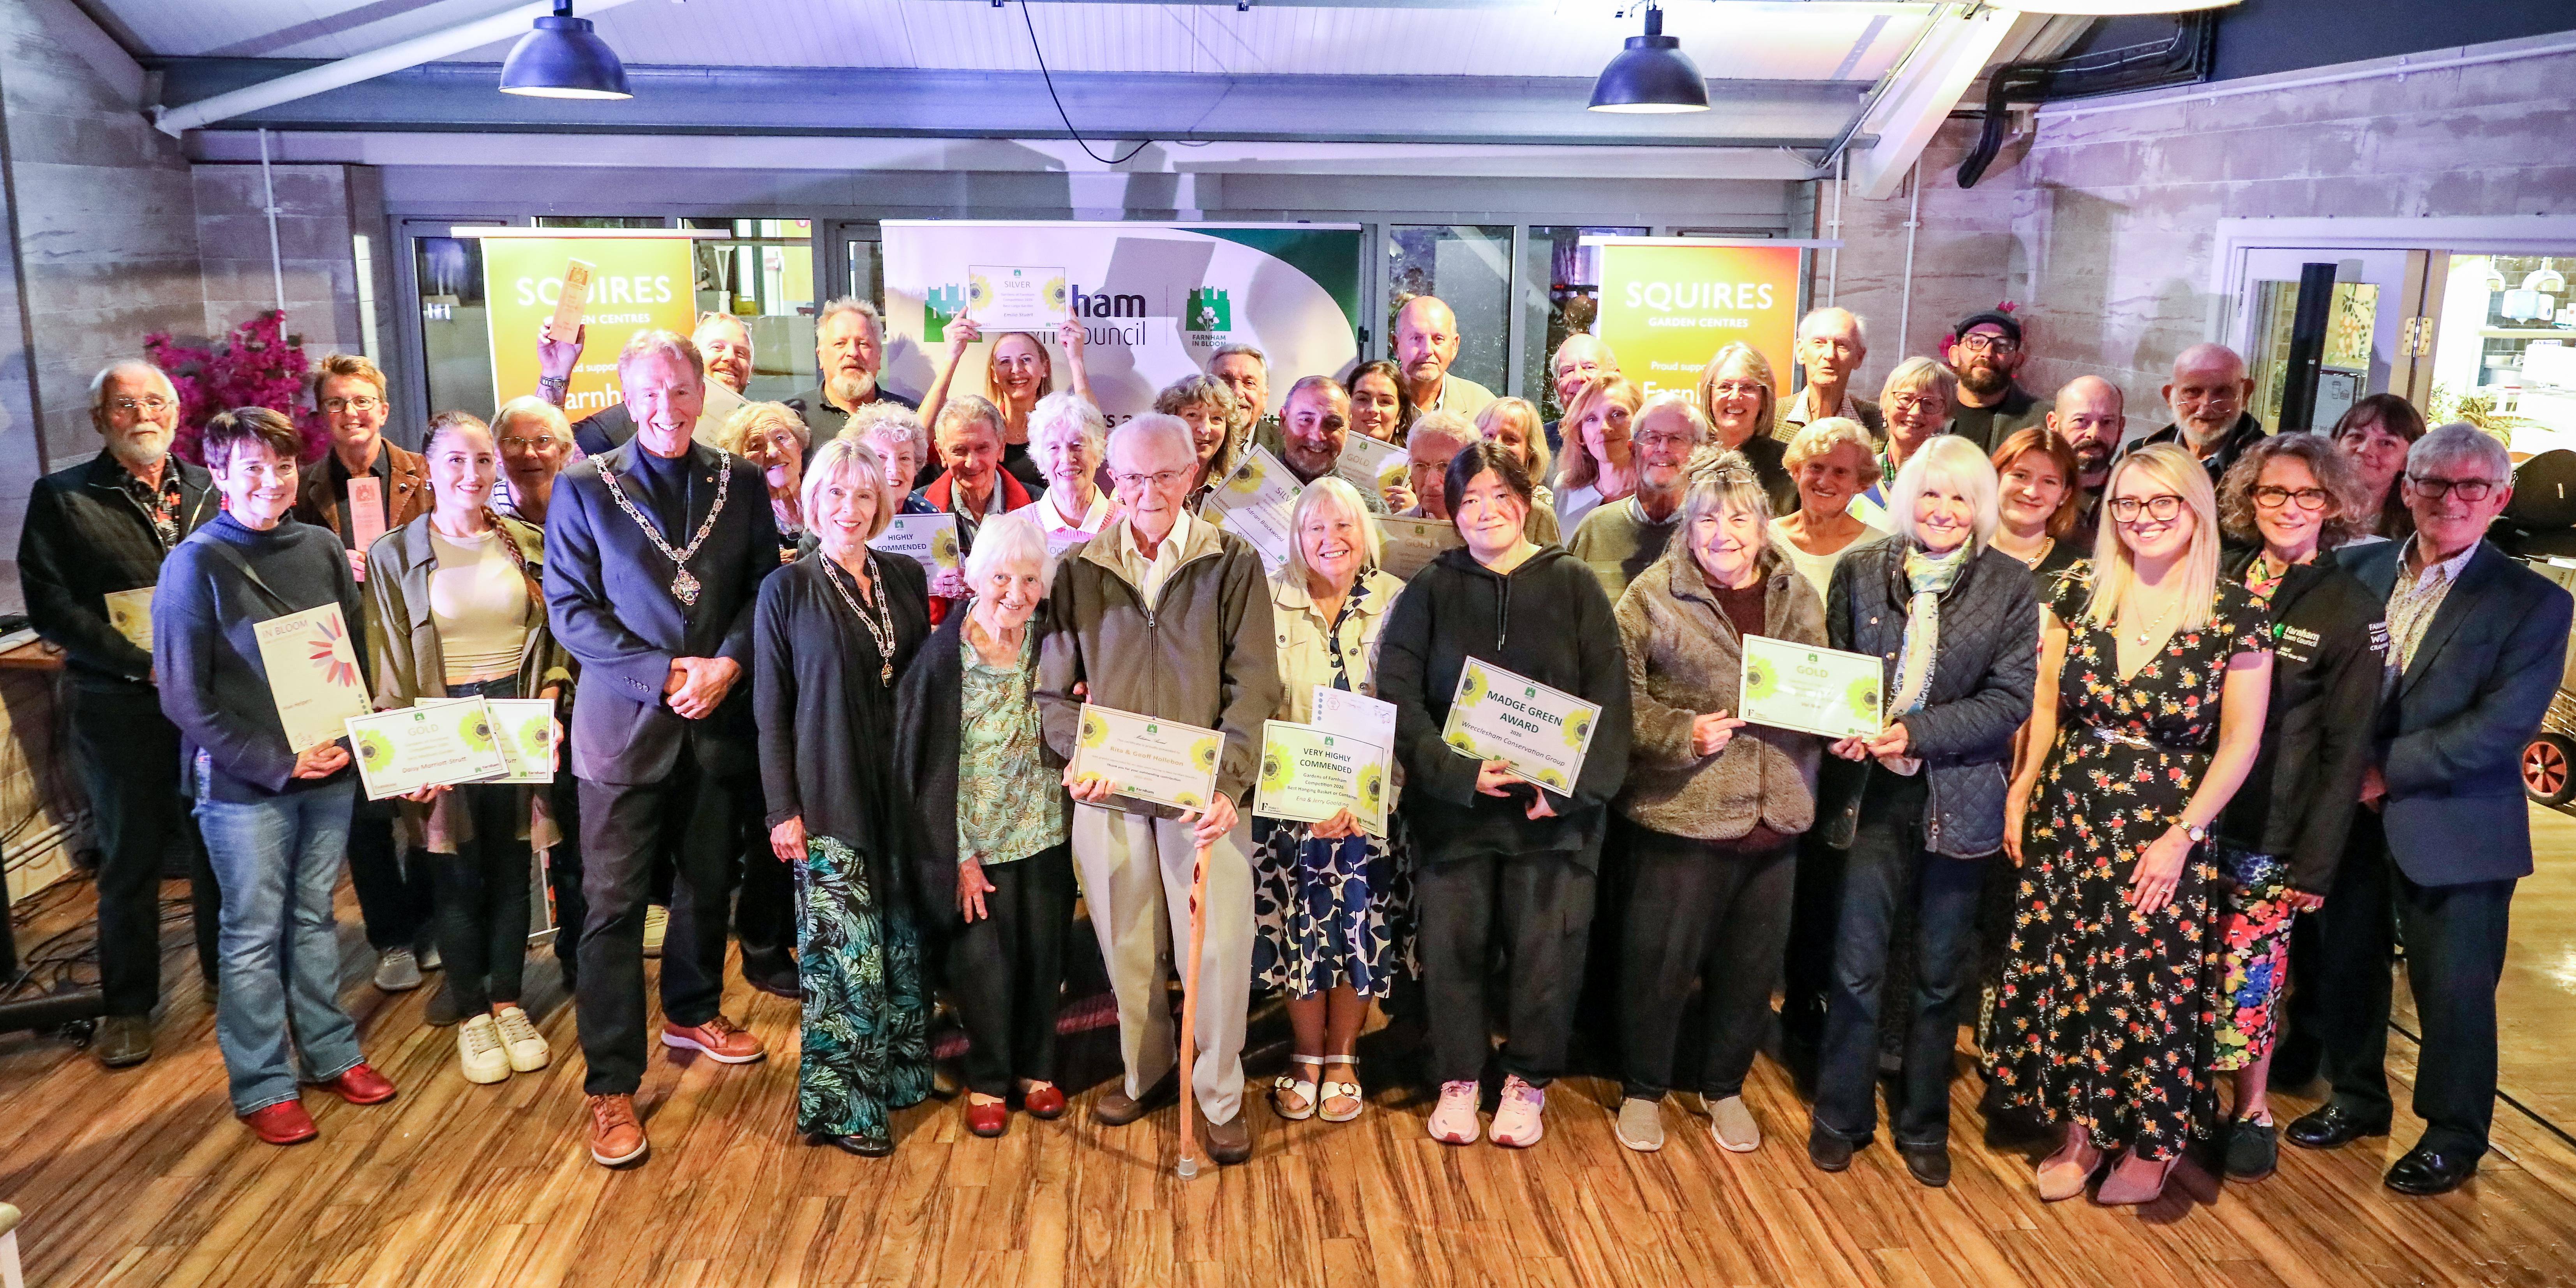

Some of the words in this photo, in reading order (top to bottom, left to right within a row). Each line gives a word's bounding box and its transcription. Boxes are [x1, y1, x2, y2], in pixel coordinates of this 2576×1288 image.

[1626, 281, 1773, 311] SQUIRES
[599, 313, 650, 324] CENTRES
[1648, 317, 1695, 327] GARDEN
[1699, 318, 1748, 328] CENTRES
[1084, 321, 1145, 346] ouncil
[1651, 361, 1678, 371] Proud
[1347, 453, 1370, 466] GOLD
[1275, 487, 1296, 507] SILVE
[1245, 507, 1260, 522] Adrian
[1260, 520, 1285, 543] Blackwood
[1405, 538, 1433, 549] GOLD
[262, 627, 273, 639] IN
[275, 619, 308, 635] BLOOM
[2285, 626, 2320, 641] Farnham
[2296, 637, 2318, 648] Council
[1796, 665, 1828, 678] GOLD
[1487, 690, 1526, 712] MADGE
[1528, 707, 1563, 727] GREEN
[408, 723, 439, 736] GOLD
[1500, 713, 1539, 733] AWARD
[1462, 721, 1502, 741] Wrecclesham
[1503, 738, 1544, 758] Conservation
[1545, 754, 1565, 767] Group
[1153, 756, 1184, 766] Hollebon
[1304, 748, 1323, 757] VERY
[1325, 751, 1351, 762] HIGHLY
[402, 764, 419, 773] Daisy
[1300, 759, 1352, 774] COMMENDED
[1326, 800, 1349, 808] Goolding
[1362, 818, 1376, 826] Farnham
